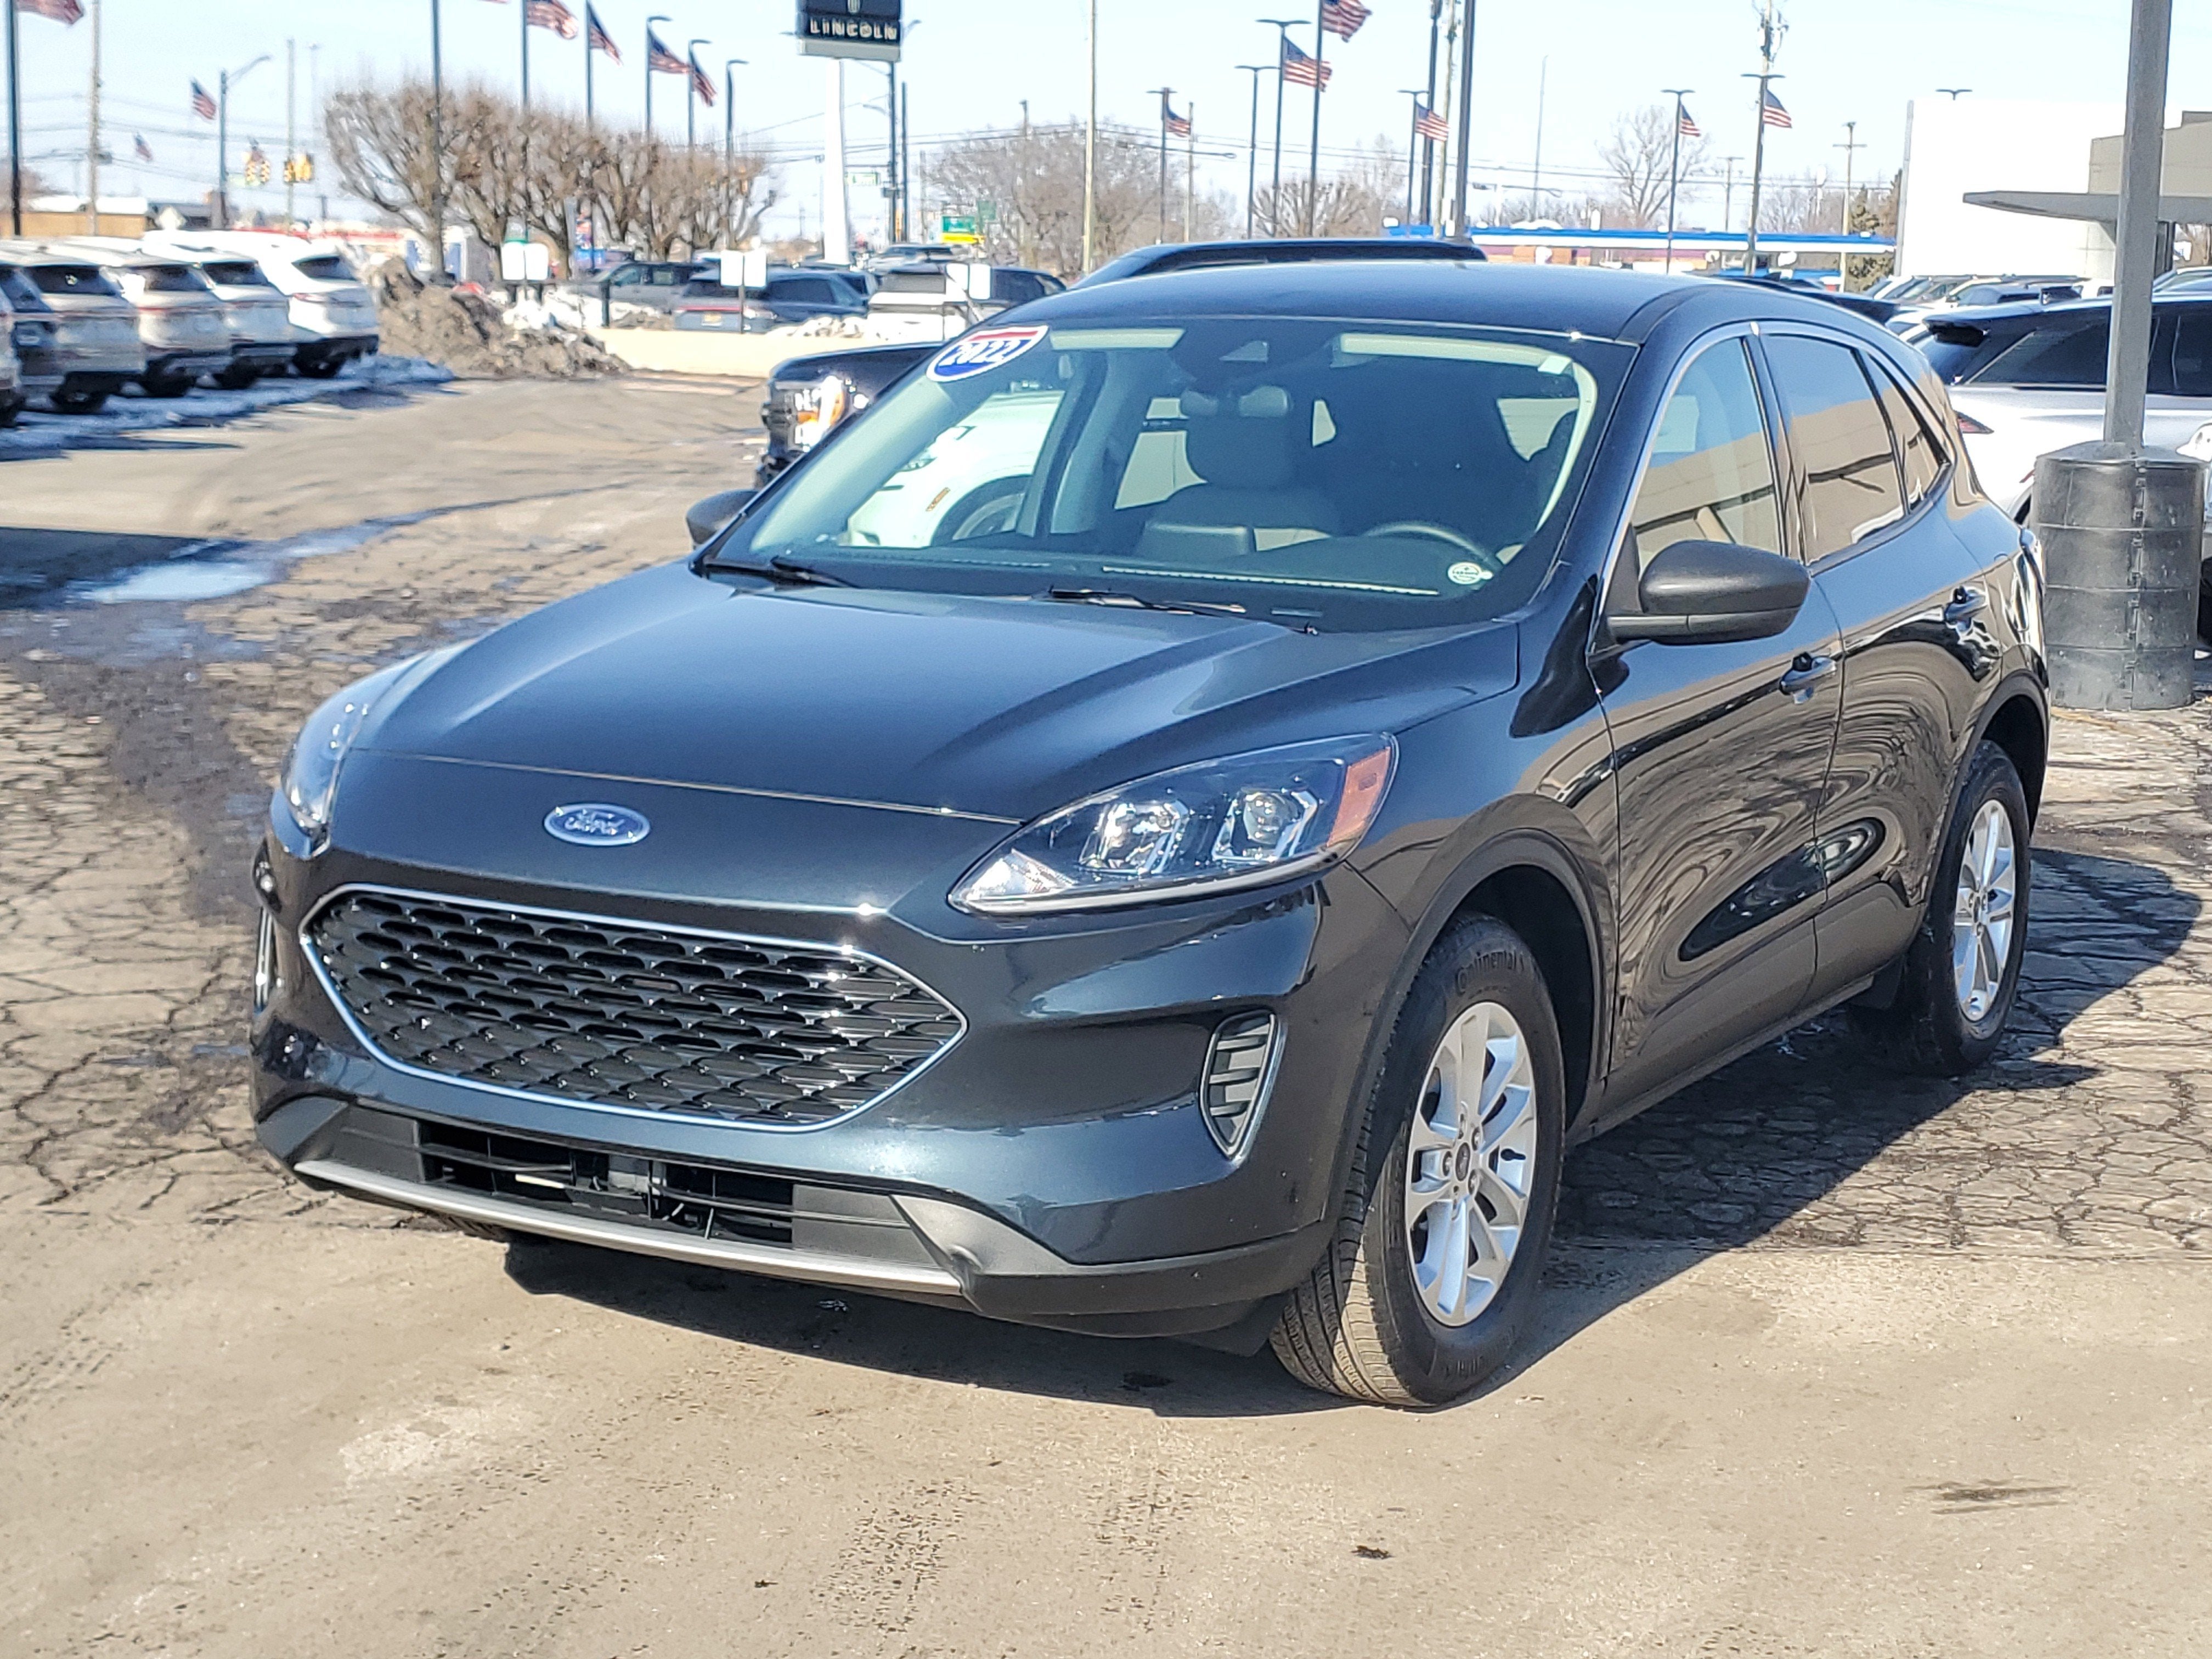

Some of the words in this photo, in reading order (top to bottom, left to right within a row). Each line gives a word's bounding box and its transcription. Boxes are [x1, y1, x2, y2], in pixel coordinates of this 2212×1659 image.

[810, 17, 898, 40] LINCOLN
[938, 340, 1021, 366] 2022
[565, 809, 625, 836] Ford
